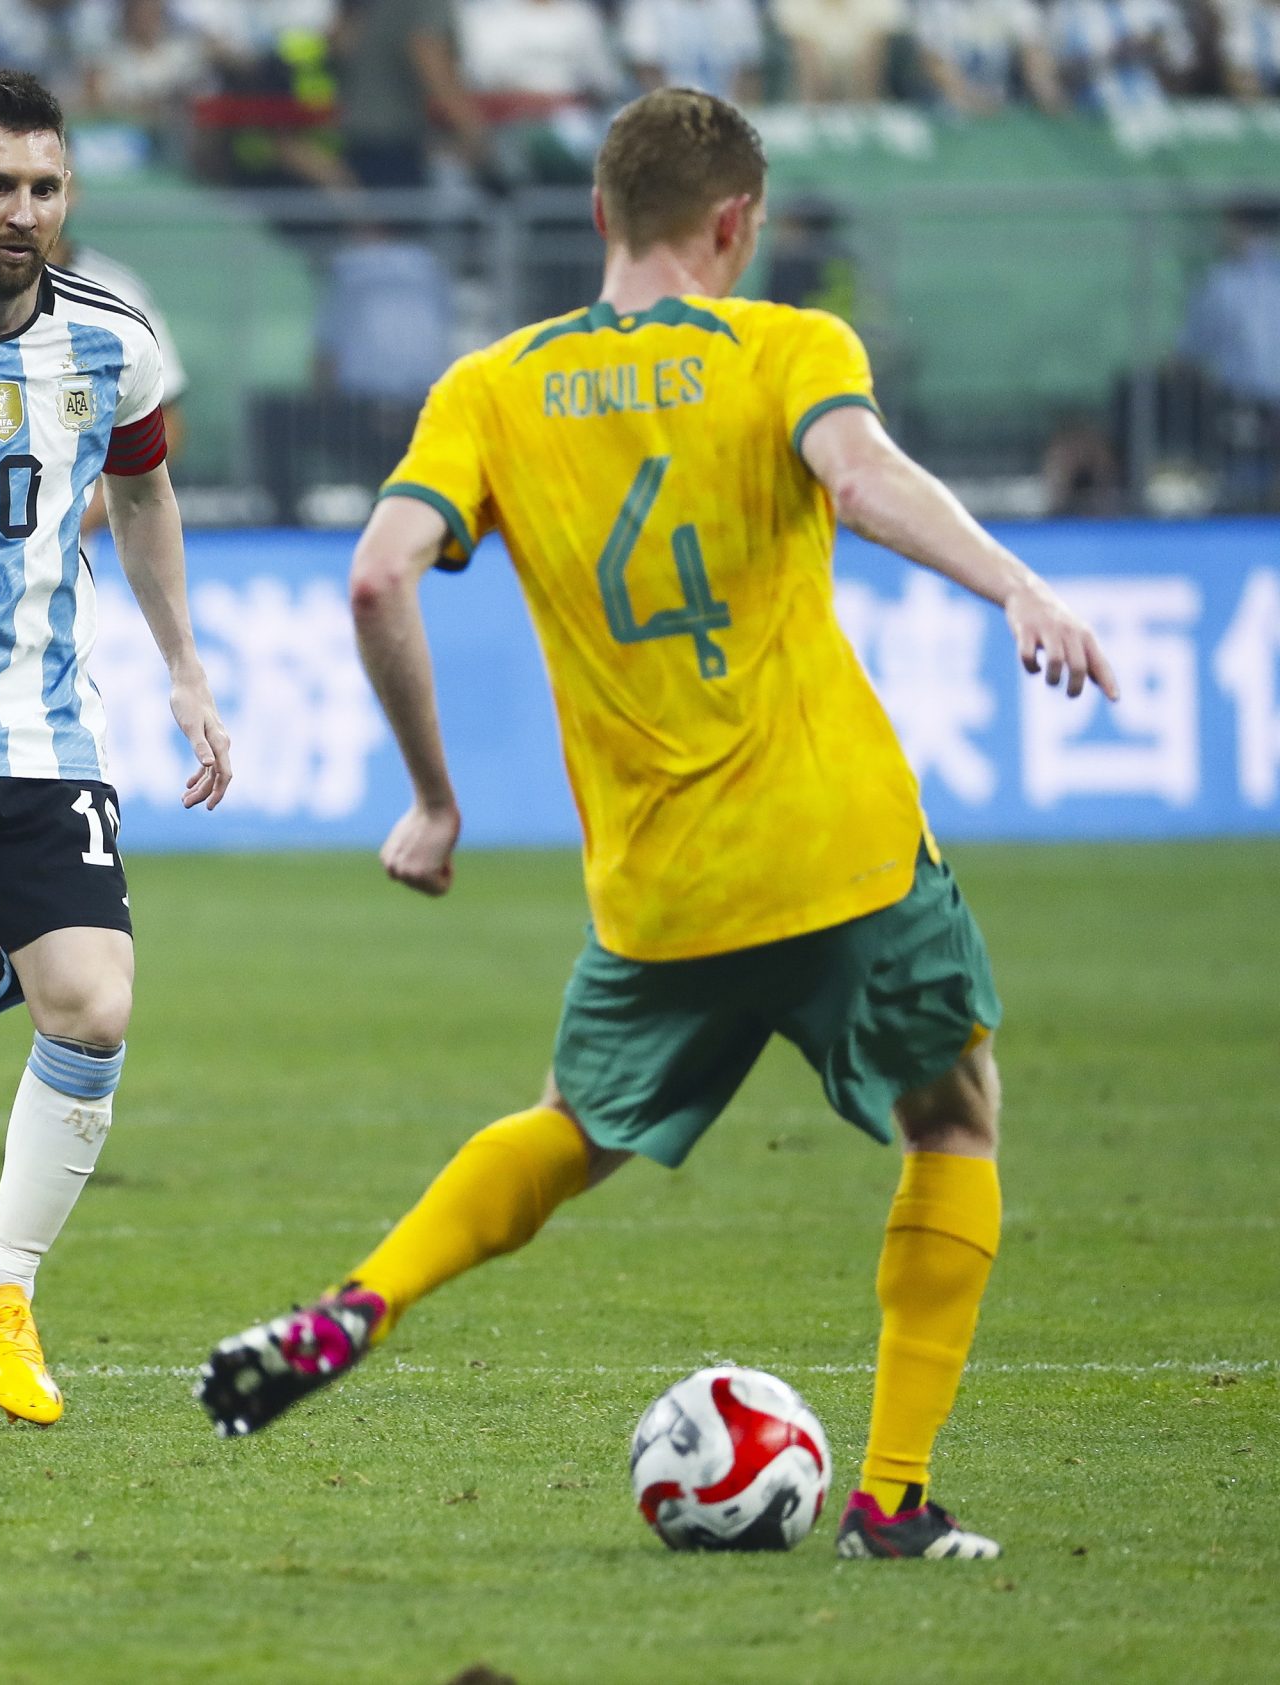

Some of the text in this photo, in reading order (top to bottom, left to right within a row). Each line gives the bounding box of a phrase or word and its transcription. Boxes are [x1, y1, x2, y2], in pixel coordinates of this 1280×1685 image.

[66, 390, 88, 416] AFA
[544, 356, 704, 419] ROWLES
[596, 455, 732, 680] 4
